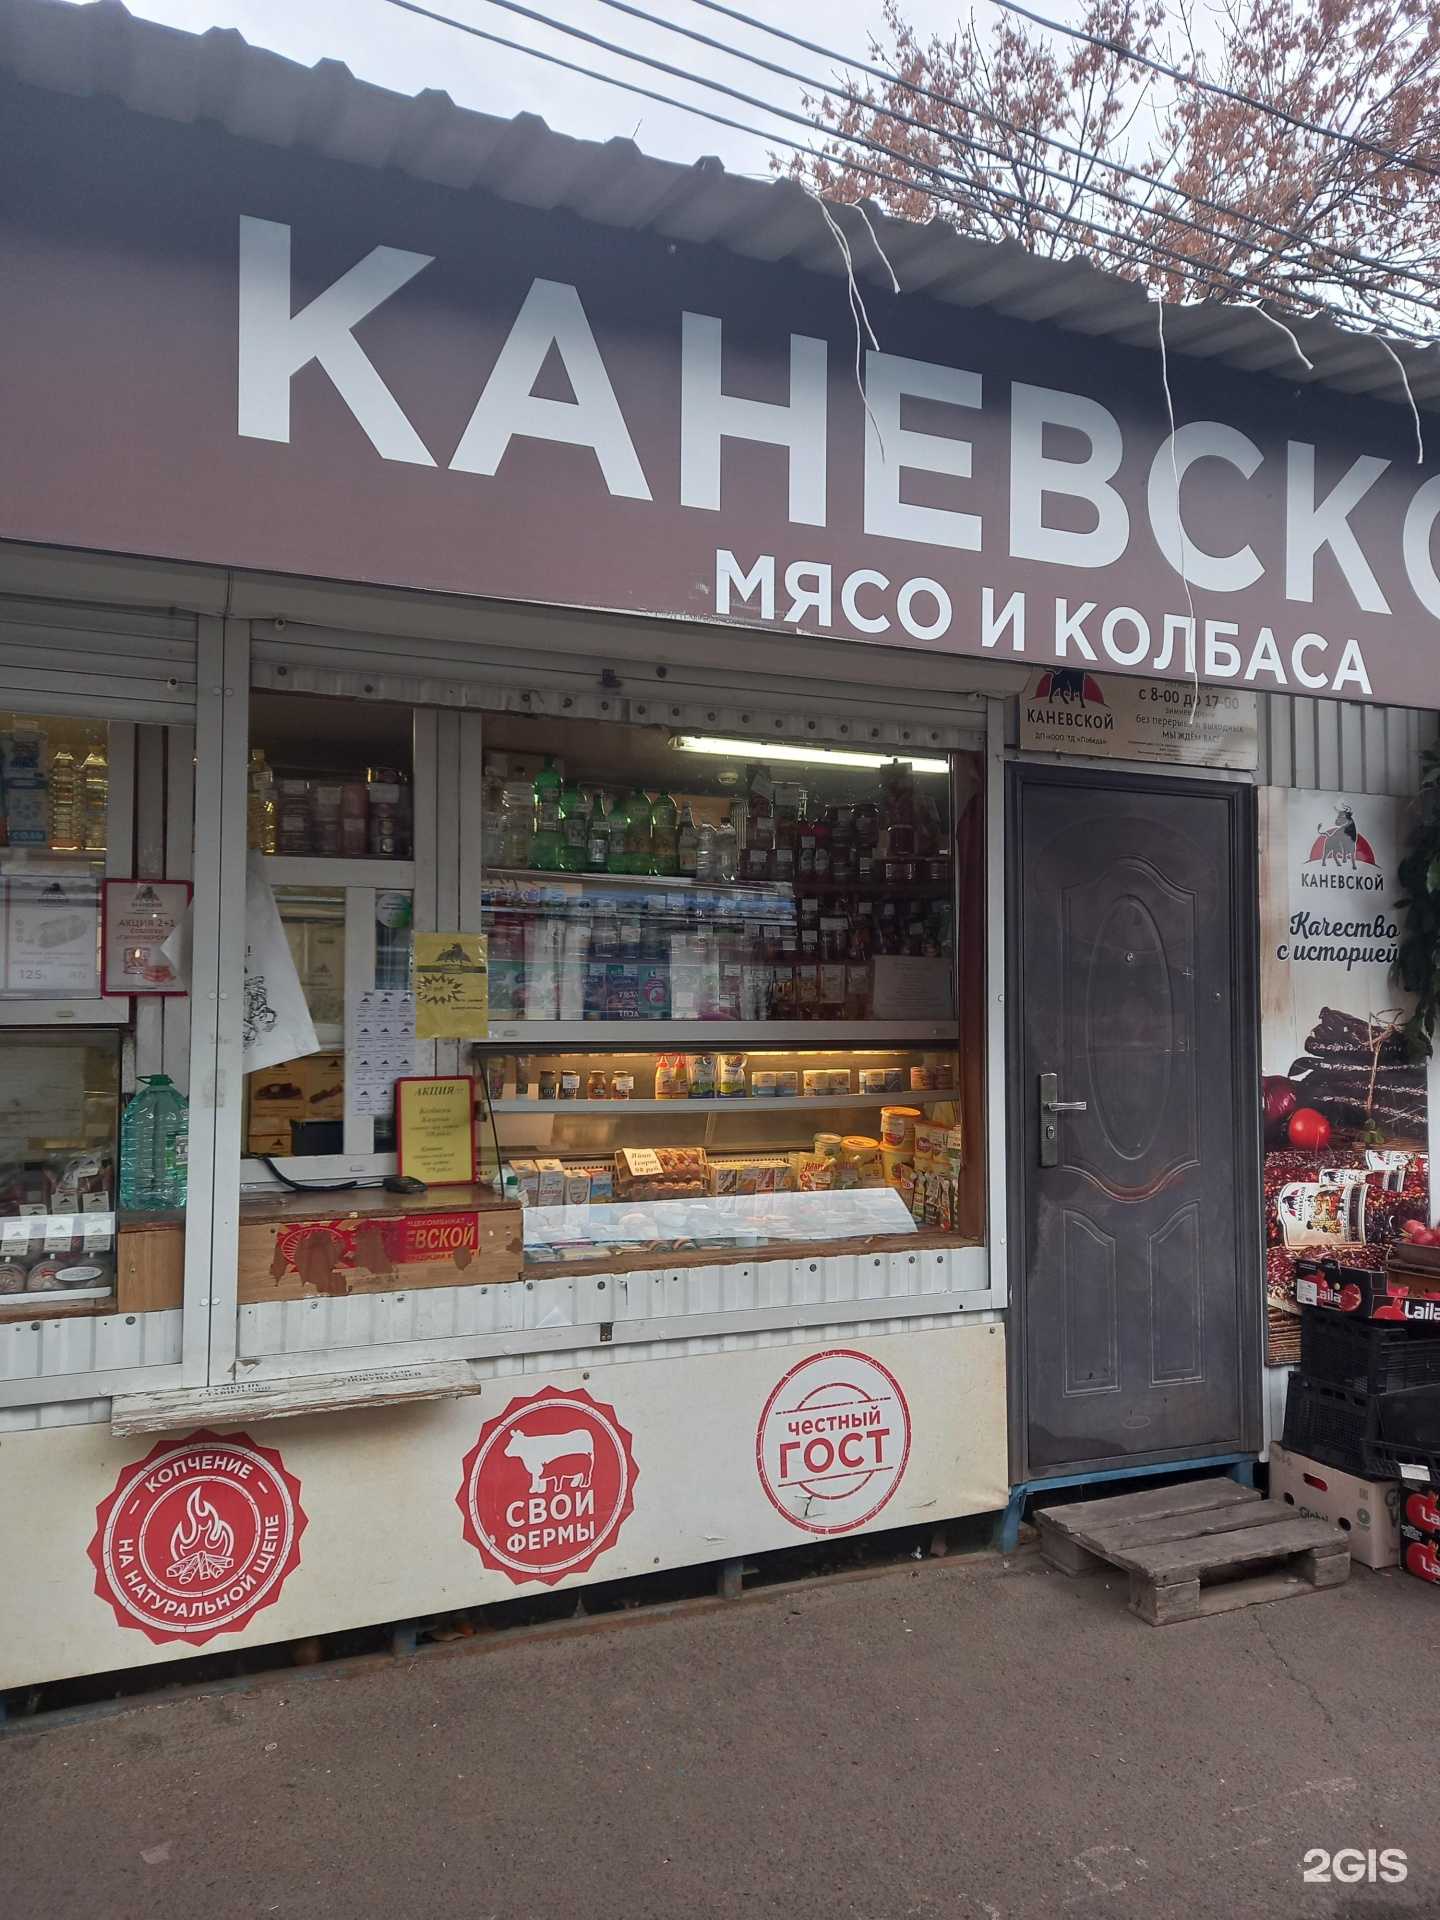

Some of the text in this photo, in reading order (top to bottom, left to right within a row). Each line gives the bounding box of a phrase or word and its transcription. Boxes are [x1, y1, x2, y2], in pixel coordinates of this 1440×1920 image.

[715, 549, 1373, 695] МЯСО И КОЛБАСА
[1150, 687, 1180, 704] 8-00
[1183, 692, 1201, 708] до
[1027, 708, 1114, 730] КАНЕВСКОЙ
[1301, 872, 1385, 891] КАНЕВСКОЙ
[1290, 911, 1400, 939] Качество
[1277, 943, 1399, 972] с историей
[788, 1404, 881, 1436] честный
[779, 1428, 890, 1479] ГОСТ
[145, 1456, 253, 1493] КОПЧЕНИЕ
[506, 1489, 594, 1528] СВОИ
[506, 1521, 595, 1554] ФЕРМЫ
[118, 1514, 279, 1618] НА НАТУРАЛЬНОЙ ЩЕПЕ
